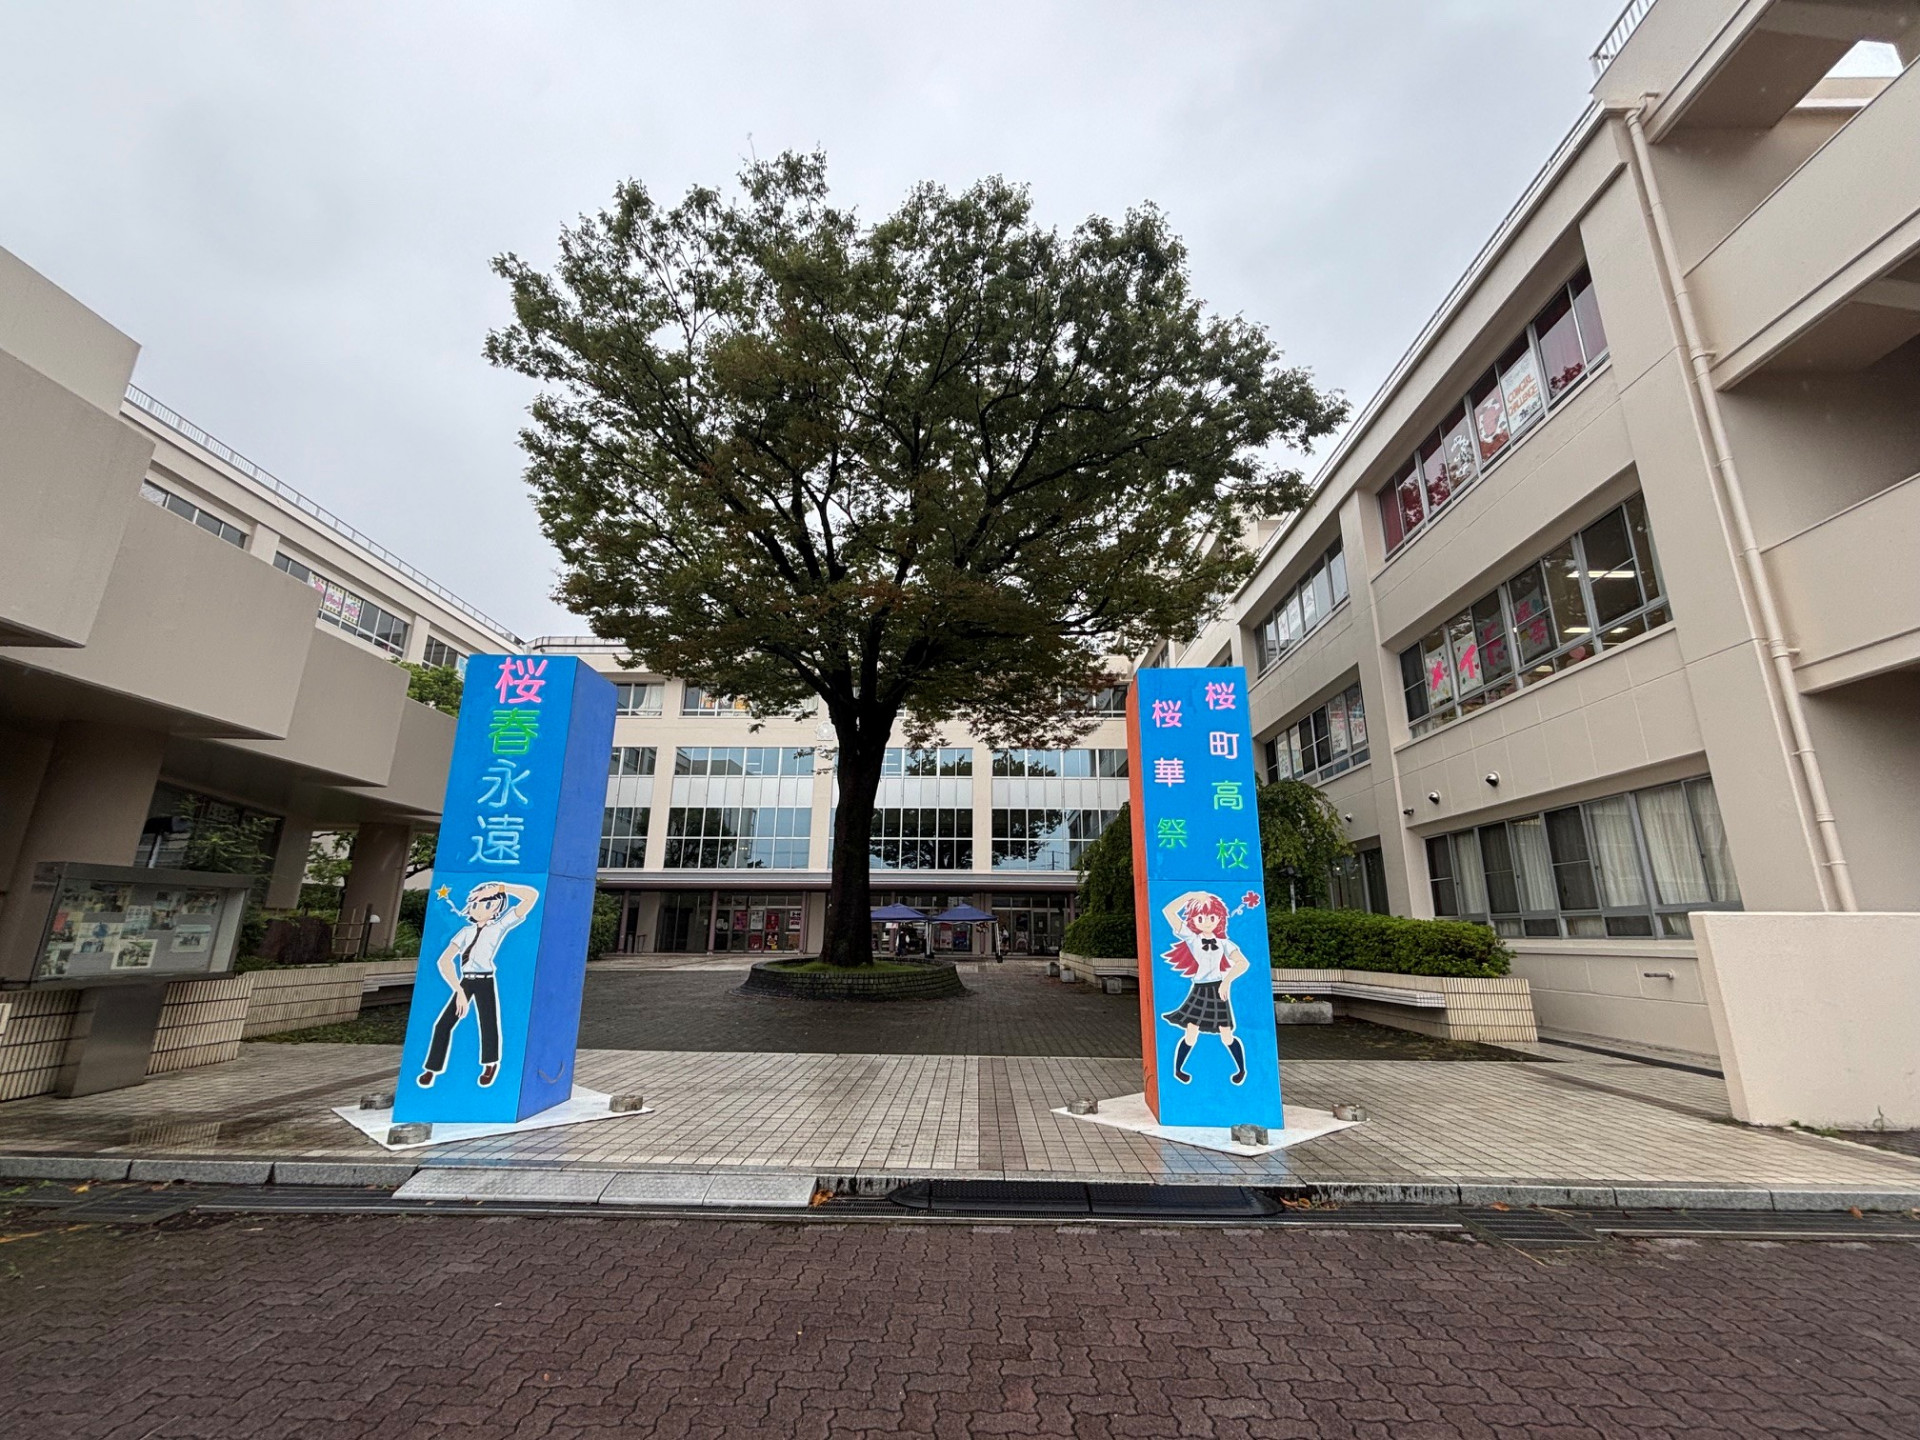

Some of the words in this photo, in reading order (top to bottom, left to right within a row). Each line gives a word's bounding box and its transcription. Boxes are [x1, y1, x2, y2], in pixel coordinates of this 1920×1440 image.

[468, 656, 548, 865] 桜春永遠
[1152, 699, 1188, 848] 桜華祭
[1204, 681, 1249, 869] 桜町高校
